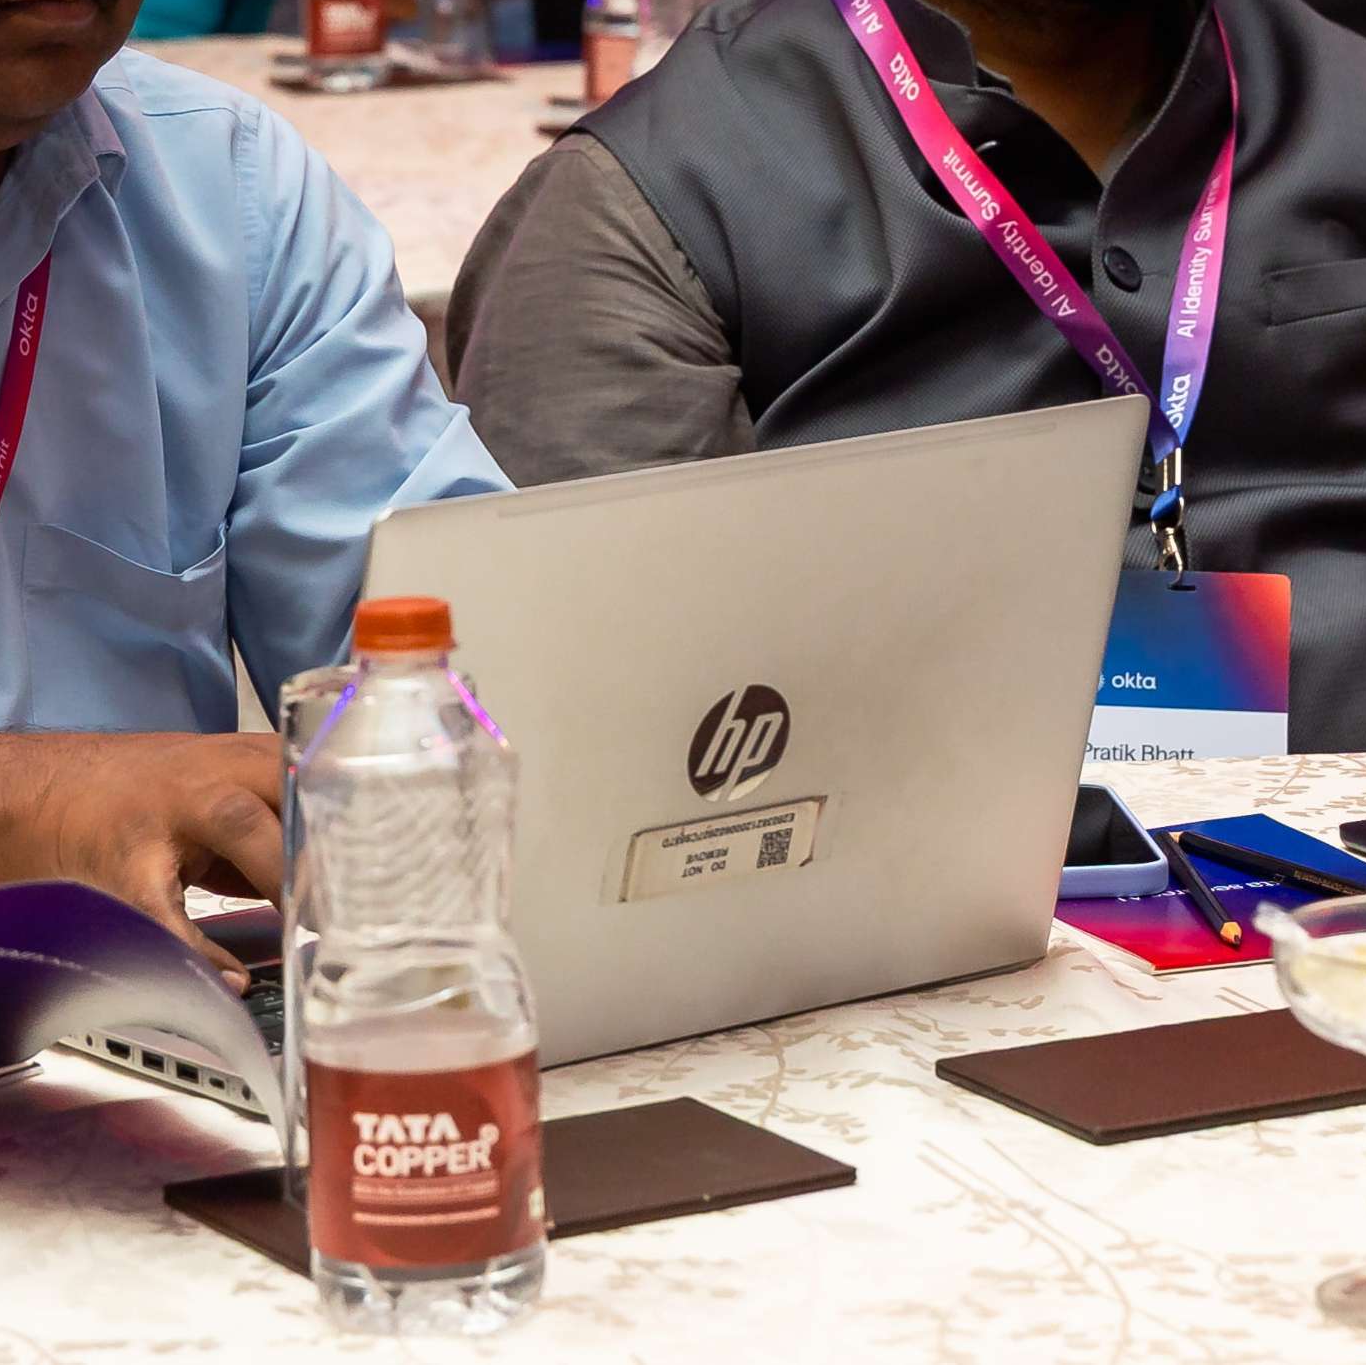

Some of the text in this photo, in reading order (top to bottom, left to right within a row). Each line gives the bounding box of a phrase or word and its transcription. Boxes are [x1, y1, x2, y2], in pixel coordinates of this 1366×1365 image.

[861, 11, 883, 35] AI
[890, 52, 920, 101] okta
[942, 147, 1077, 318] AI Identity Summit
[1177, 317, 1194, 338] AI
[1186, 245, 1212, 315] Identity
[19, 293, 39, 356] okta
[1095, 344, 1139, 396] okta
[1166, 373, 1192, 428] okta
[1111, 672, 1157, 690] okta
[692, 685, 787, 802] hp
[682, 865, 703, 878] NOT
[352, 1111, 461, 1144] TATA
[353, 1124, 500, 1177] COPPER
